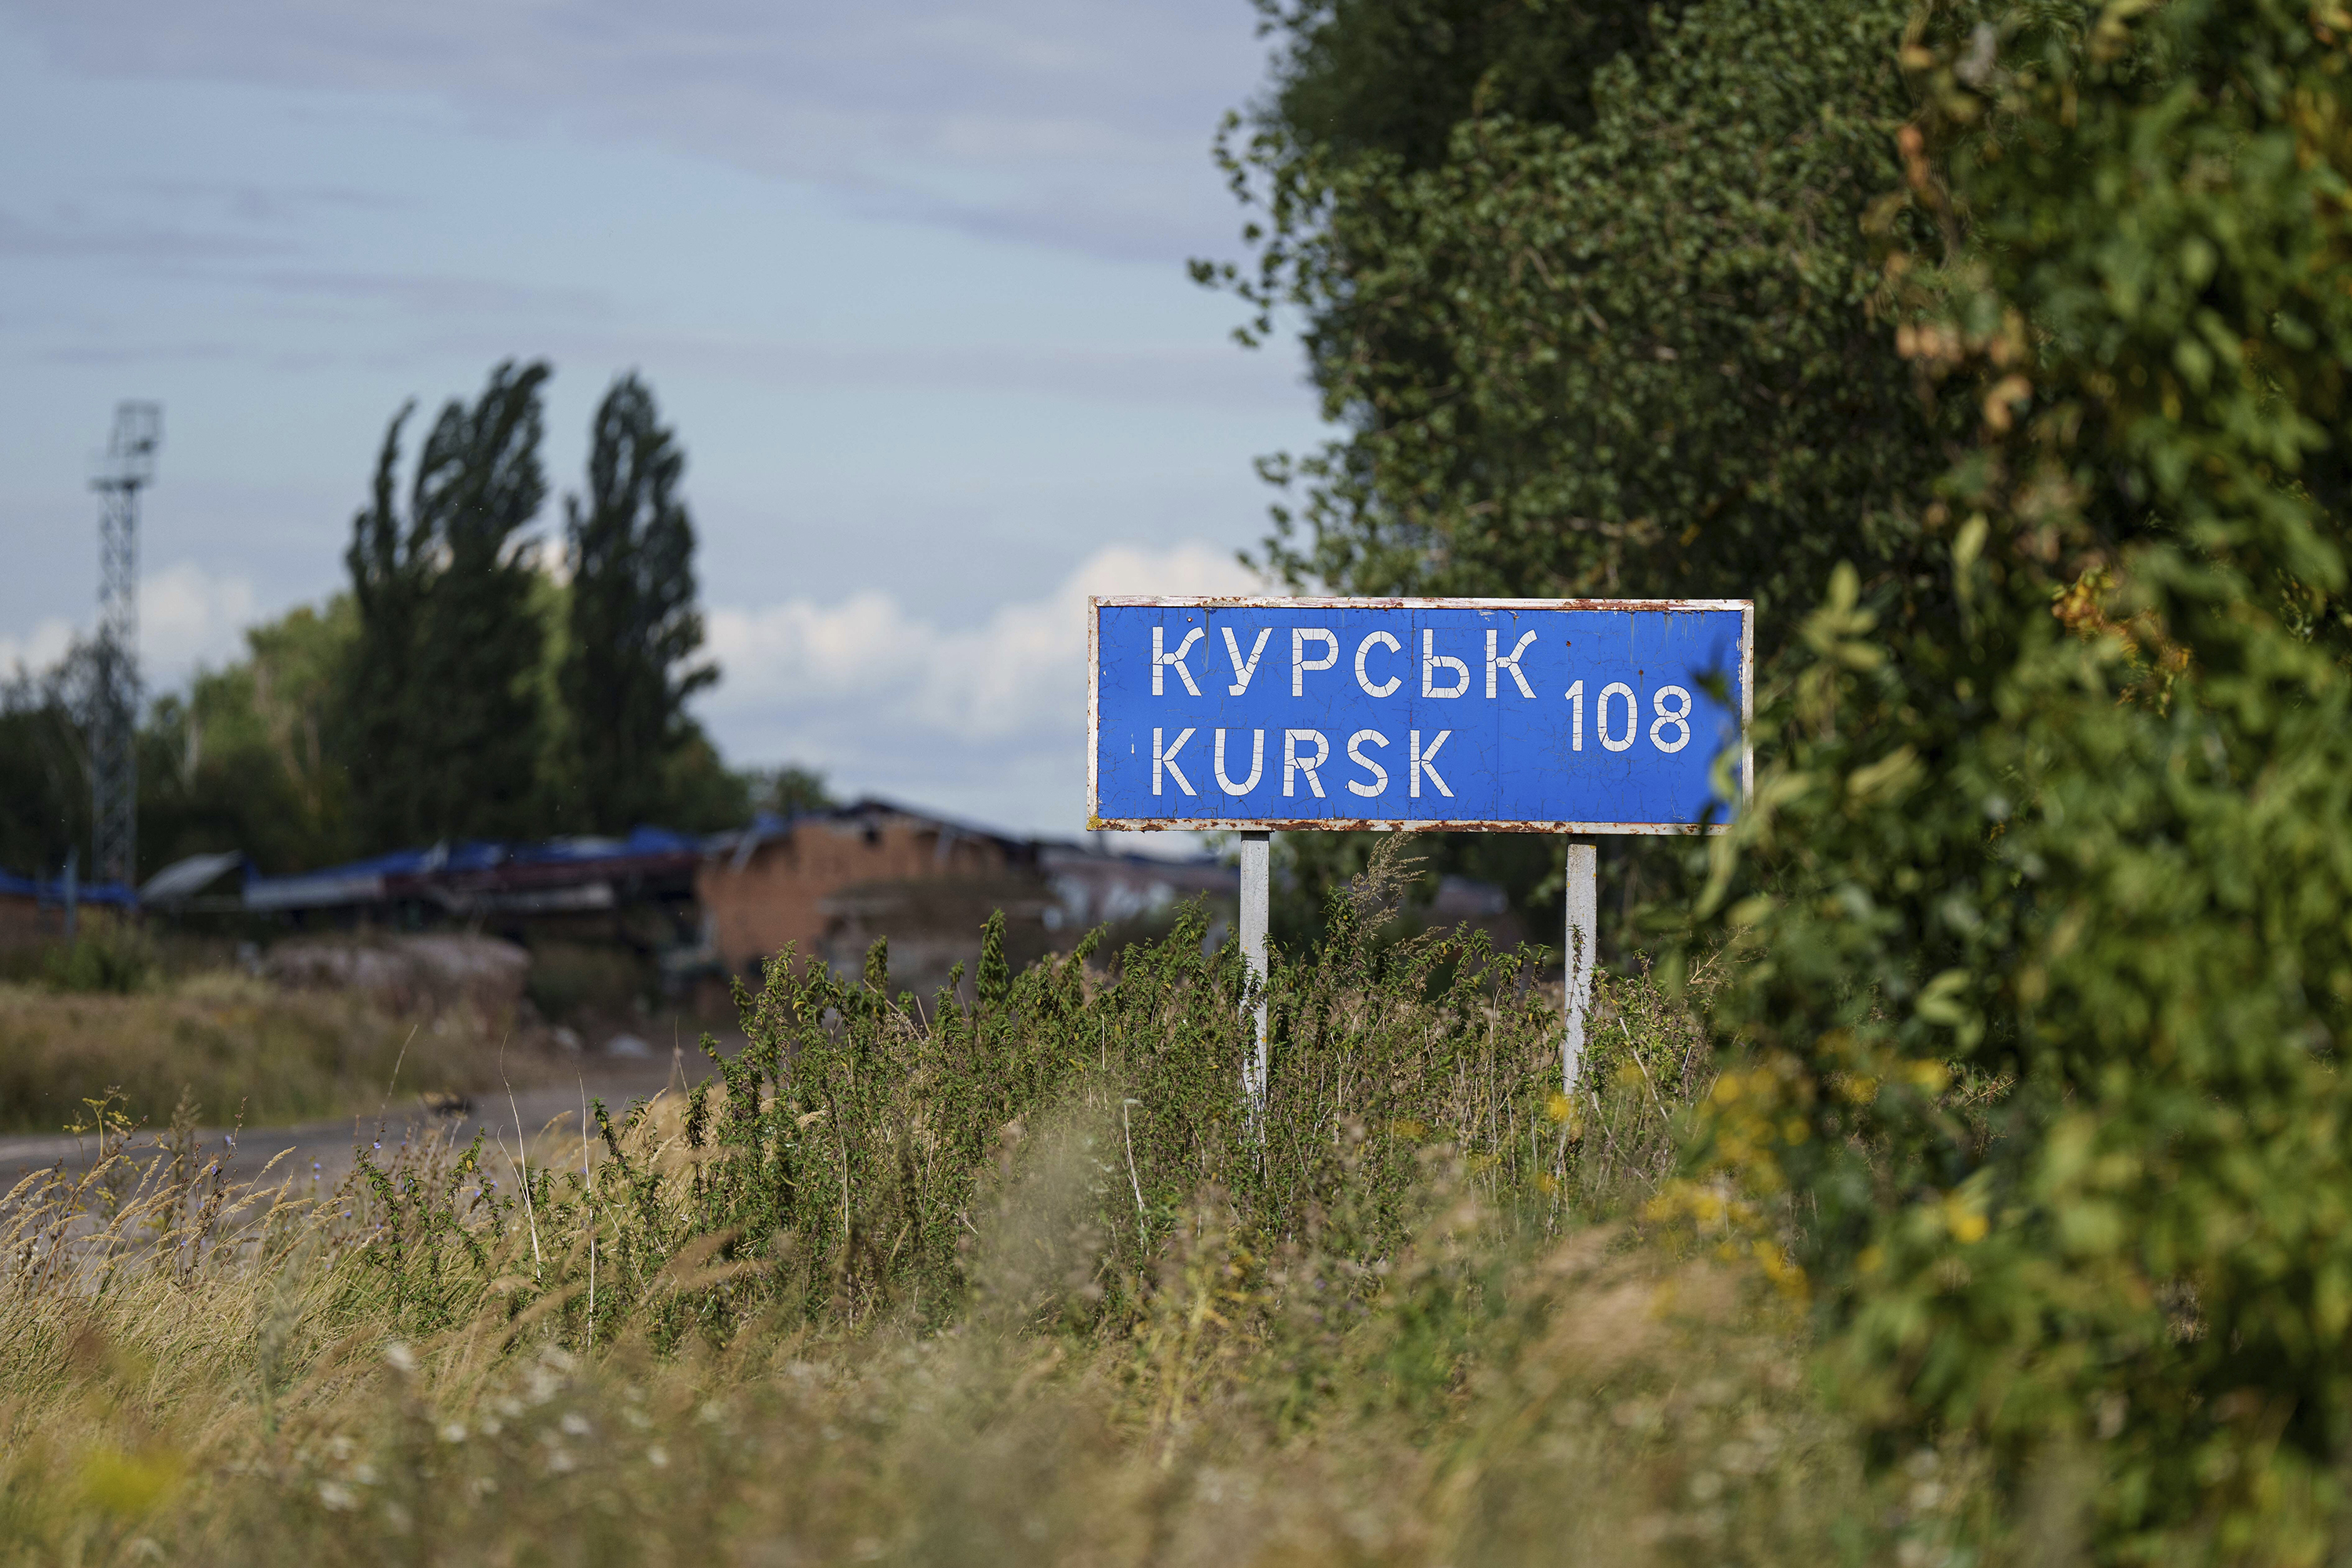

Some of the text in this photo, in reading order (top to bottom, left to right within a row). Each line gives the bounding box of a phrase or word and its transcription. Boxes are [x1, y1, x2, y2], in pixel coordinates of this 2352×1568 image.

[1152, 626, 1538, 699] КУРСЬК
[1564, 680, 1693, 753] 108
[1152, 728, 1456, 798] KURSK
